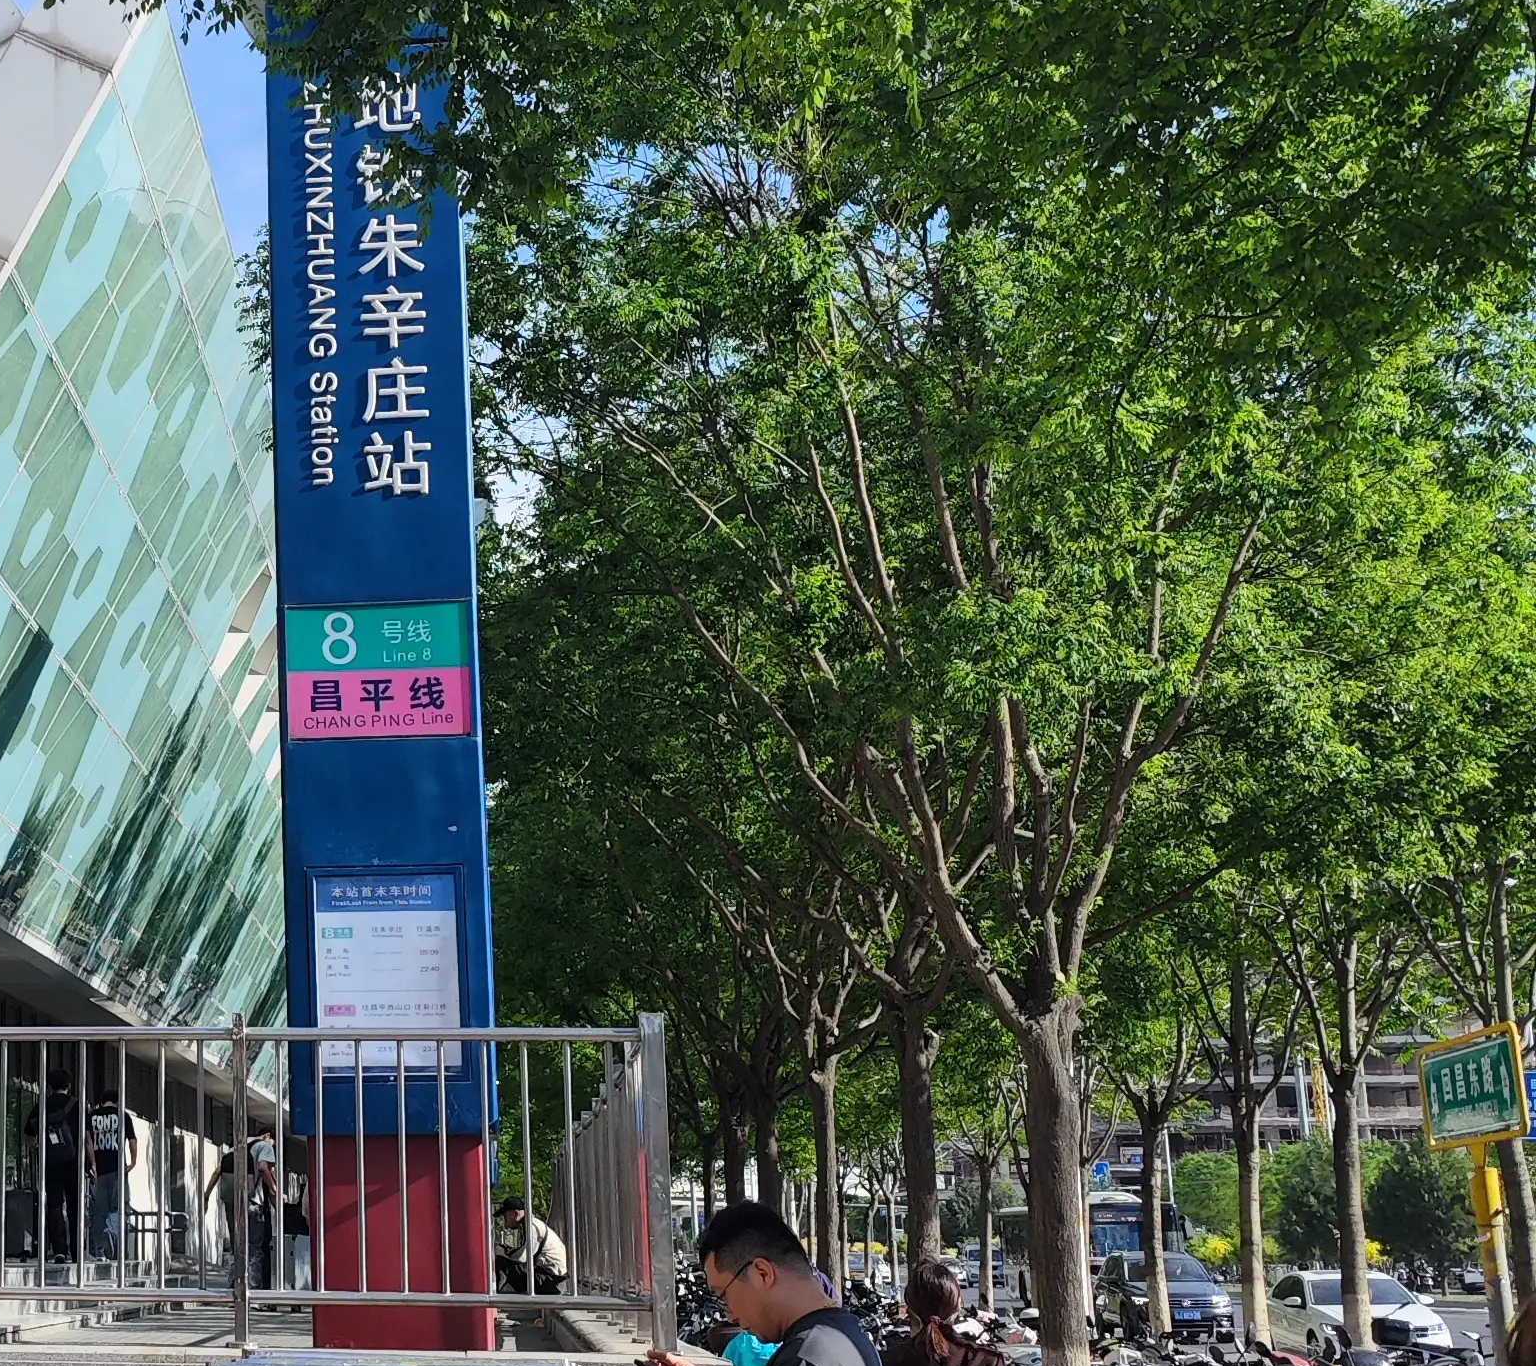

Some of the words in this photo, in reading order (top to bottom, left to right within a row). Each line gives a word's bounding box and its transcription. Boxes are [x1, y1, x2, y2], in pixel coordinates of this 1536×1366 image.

[308, 371, 340, 487] Station
[321, 611, 357, 665] 8
[381, 618, 433, 645] 号线
[382, 649, 418, 663] Line
[422, 647, 432, 661] 8
[310, 677, 445, 712] 昌平线
[421, 711, 454, 725] Line
[331, 885, 432, 898] 本站首末车时间
